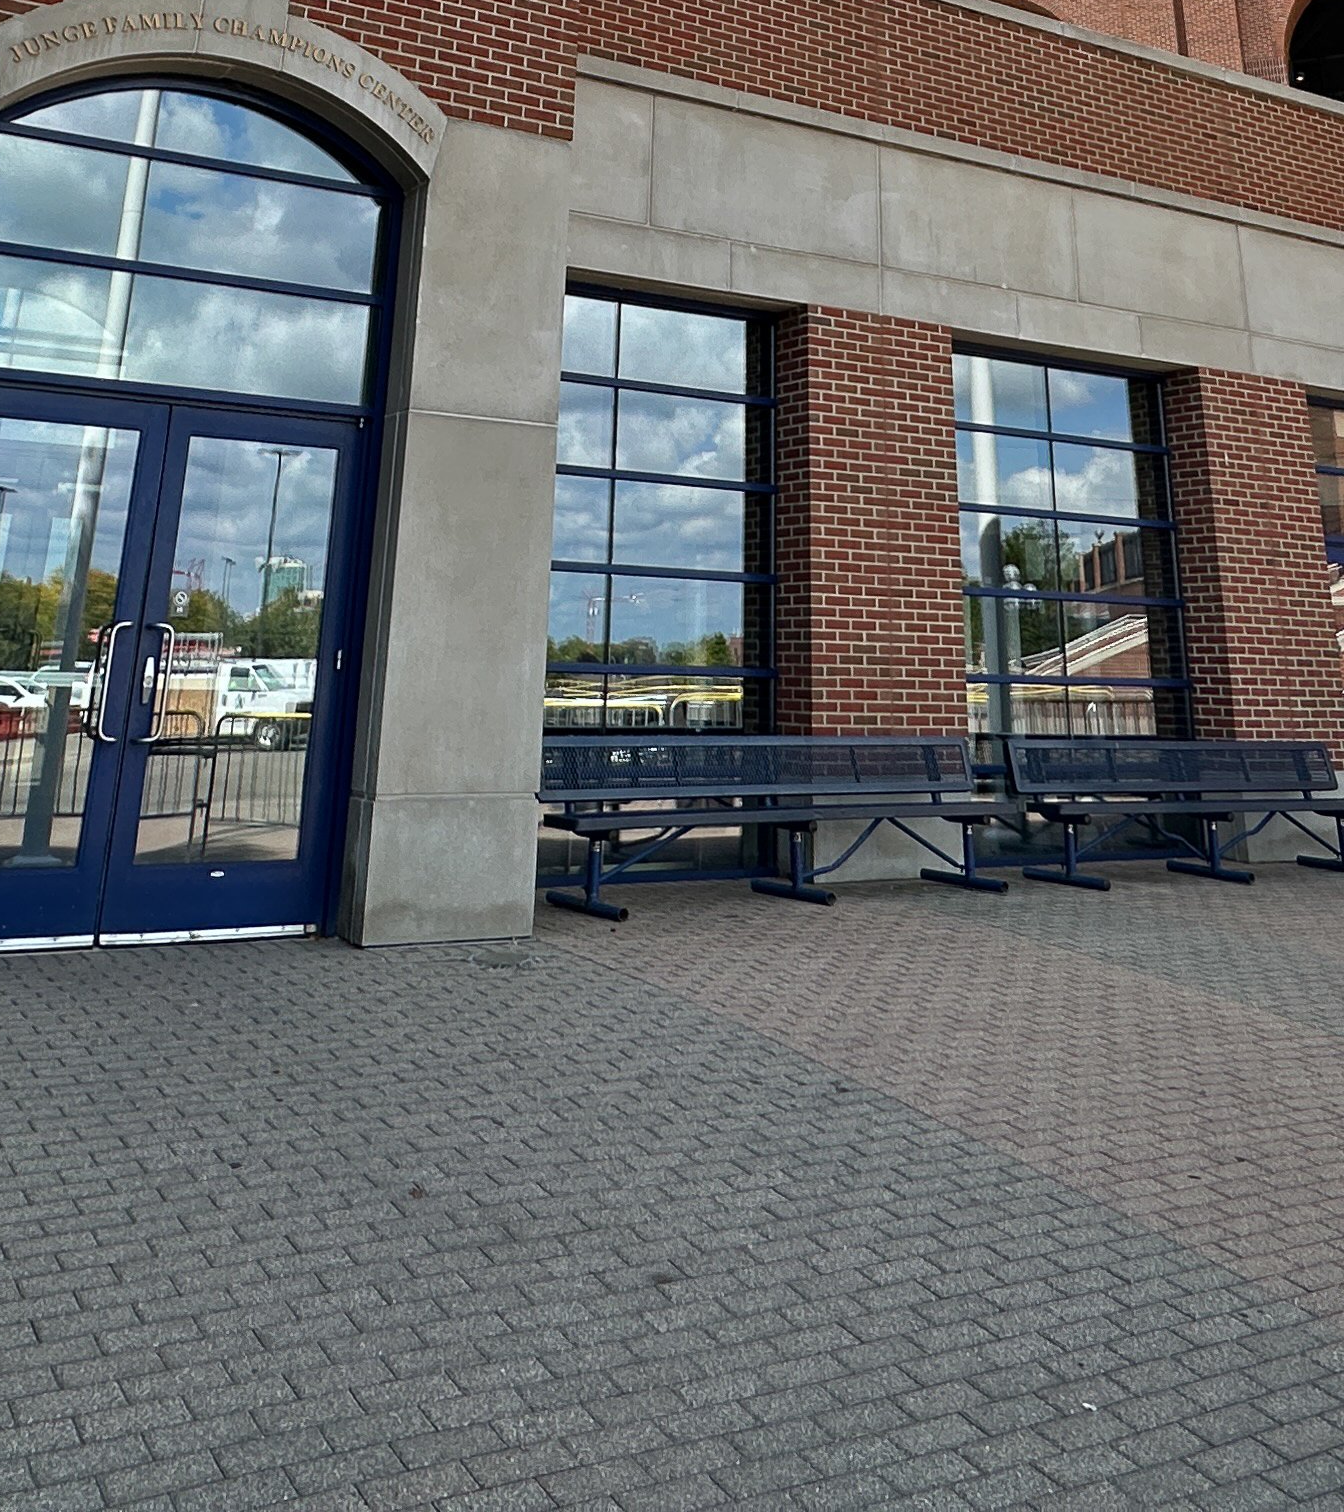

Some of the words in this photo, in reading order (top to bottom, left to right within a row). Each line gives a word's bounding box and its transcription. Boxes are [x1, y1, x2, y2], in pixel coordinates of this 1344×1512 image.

[9, 21, 99, 64] JUNGE
[101, 11, 205, 34] FAMILY
[212, 15, 357, 80] CHAMPIONS
[358, 71, 435, 144] CENTER
